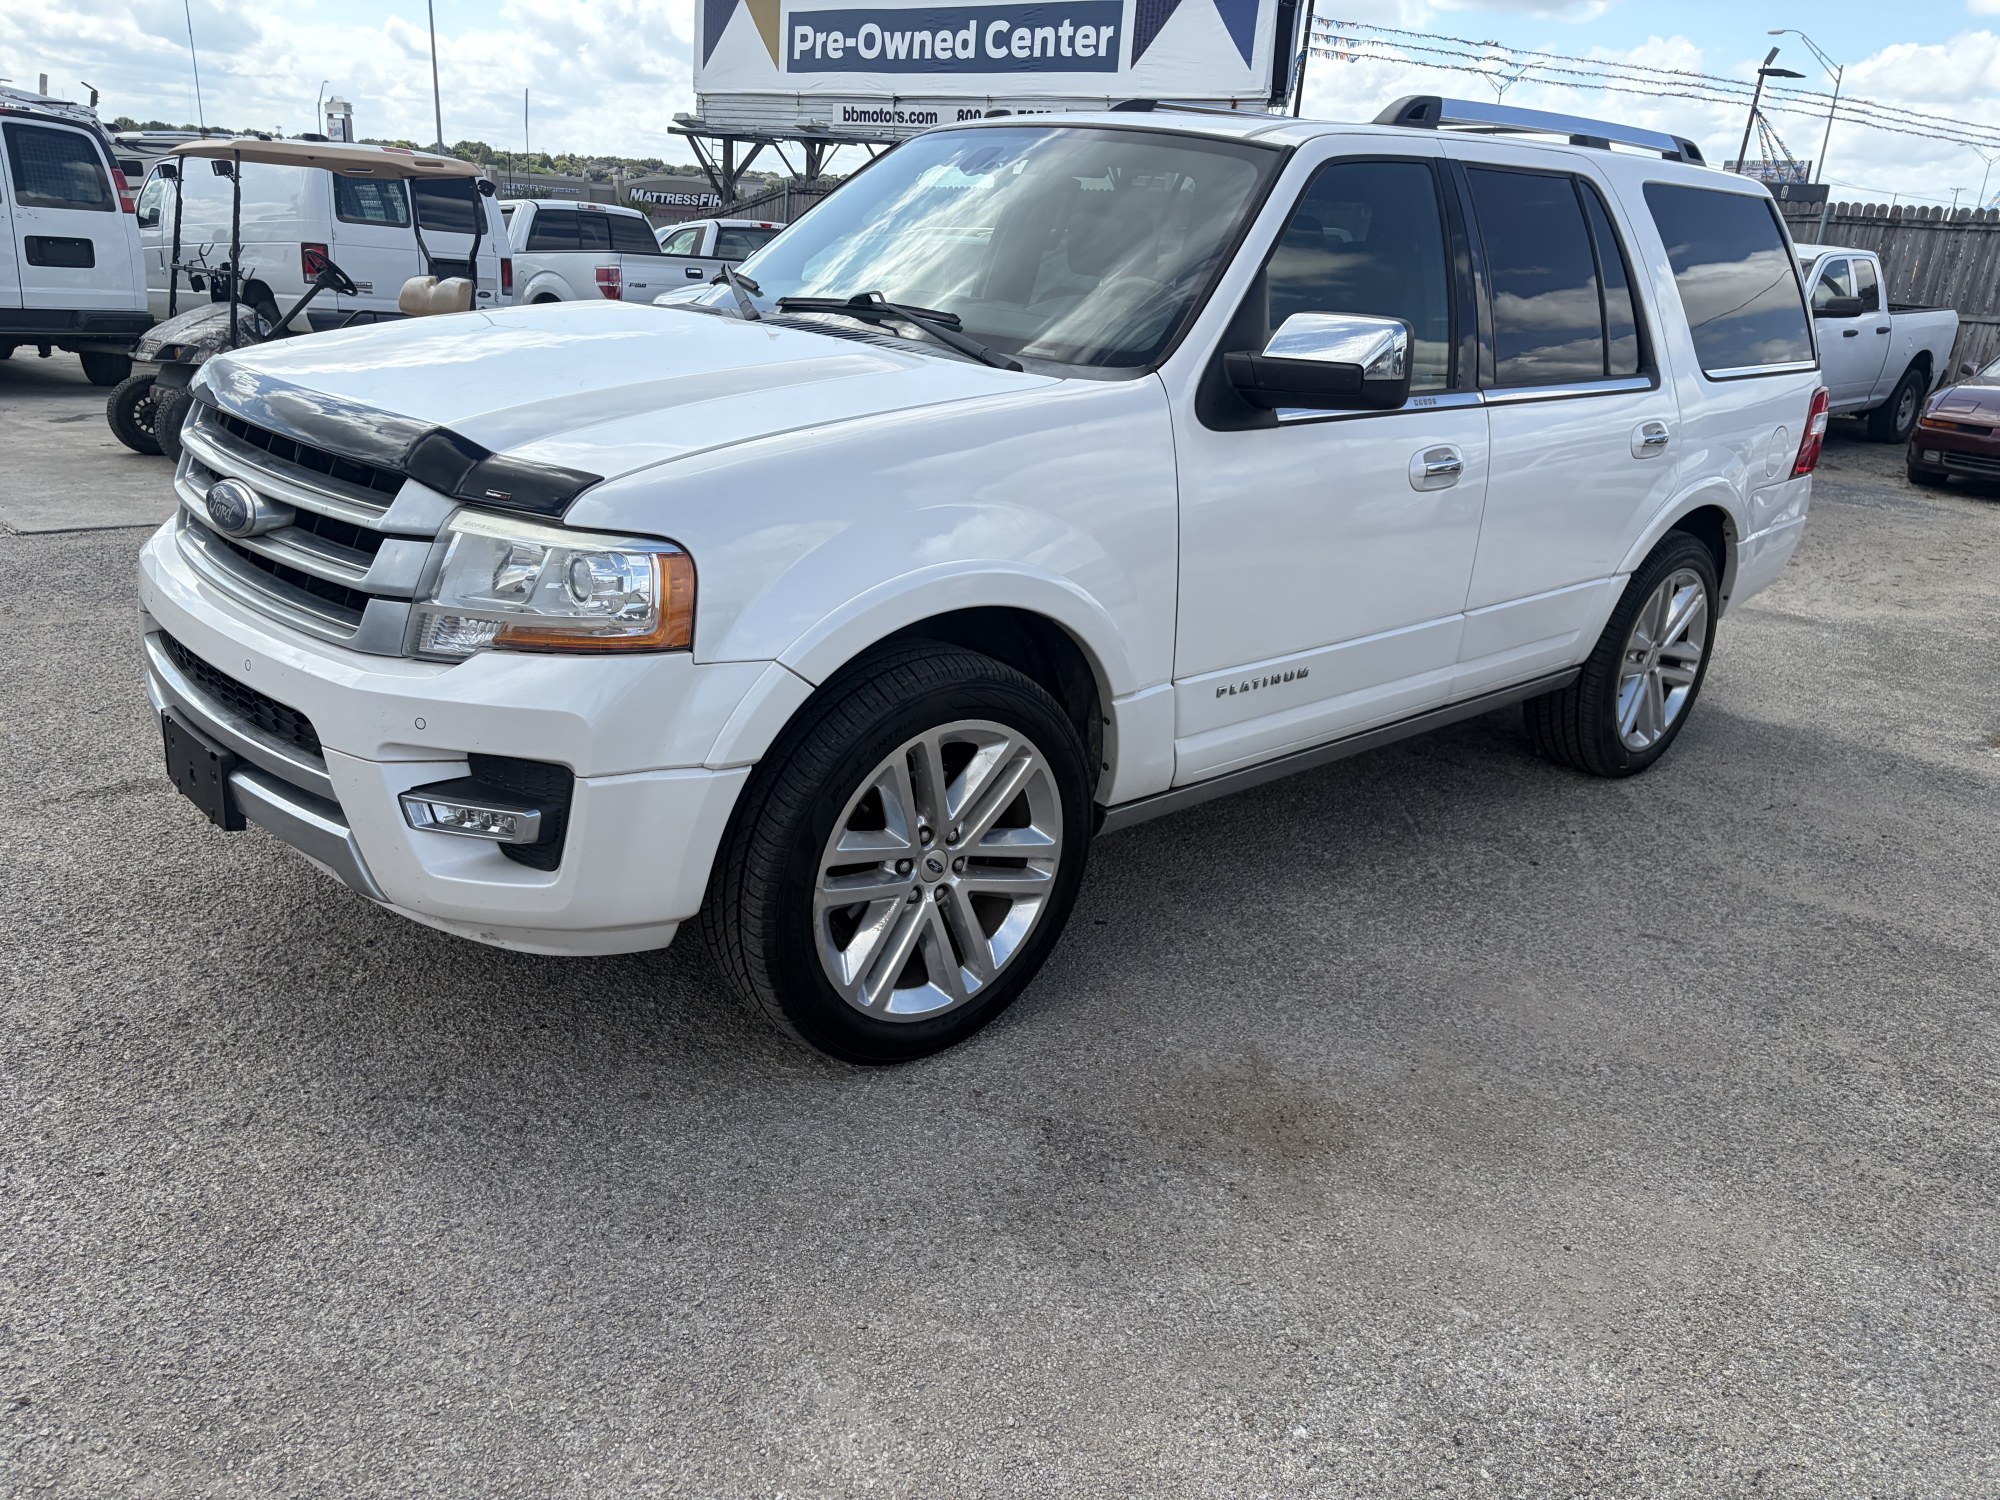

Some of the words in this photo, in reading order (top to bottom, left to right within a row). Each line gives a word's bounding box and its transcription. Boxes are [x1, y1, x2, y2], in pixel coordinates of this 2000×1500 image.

[794, 20, 977, 60] Pre-Owned
[985, 19, 1114, 59] Center
[843, 106, 938, 124] bbmotors.com
[629, 188, 723, 208] MATTRESSFIR
[1216, 667, 1310, 699] PLATINUM
